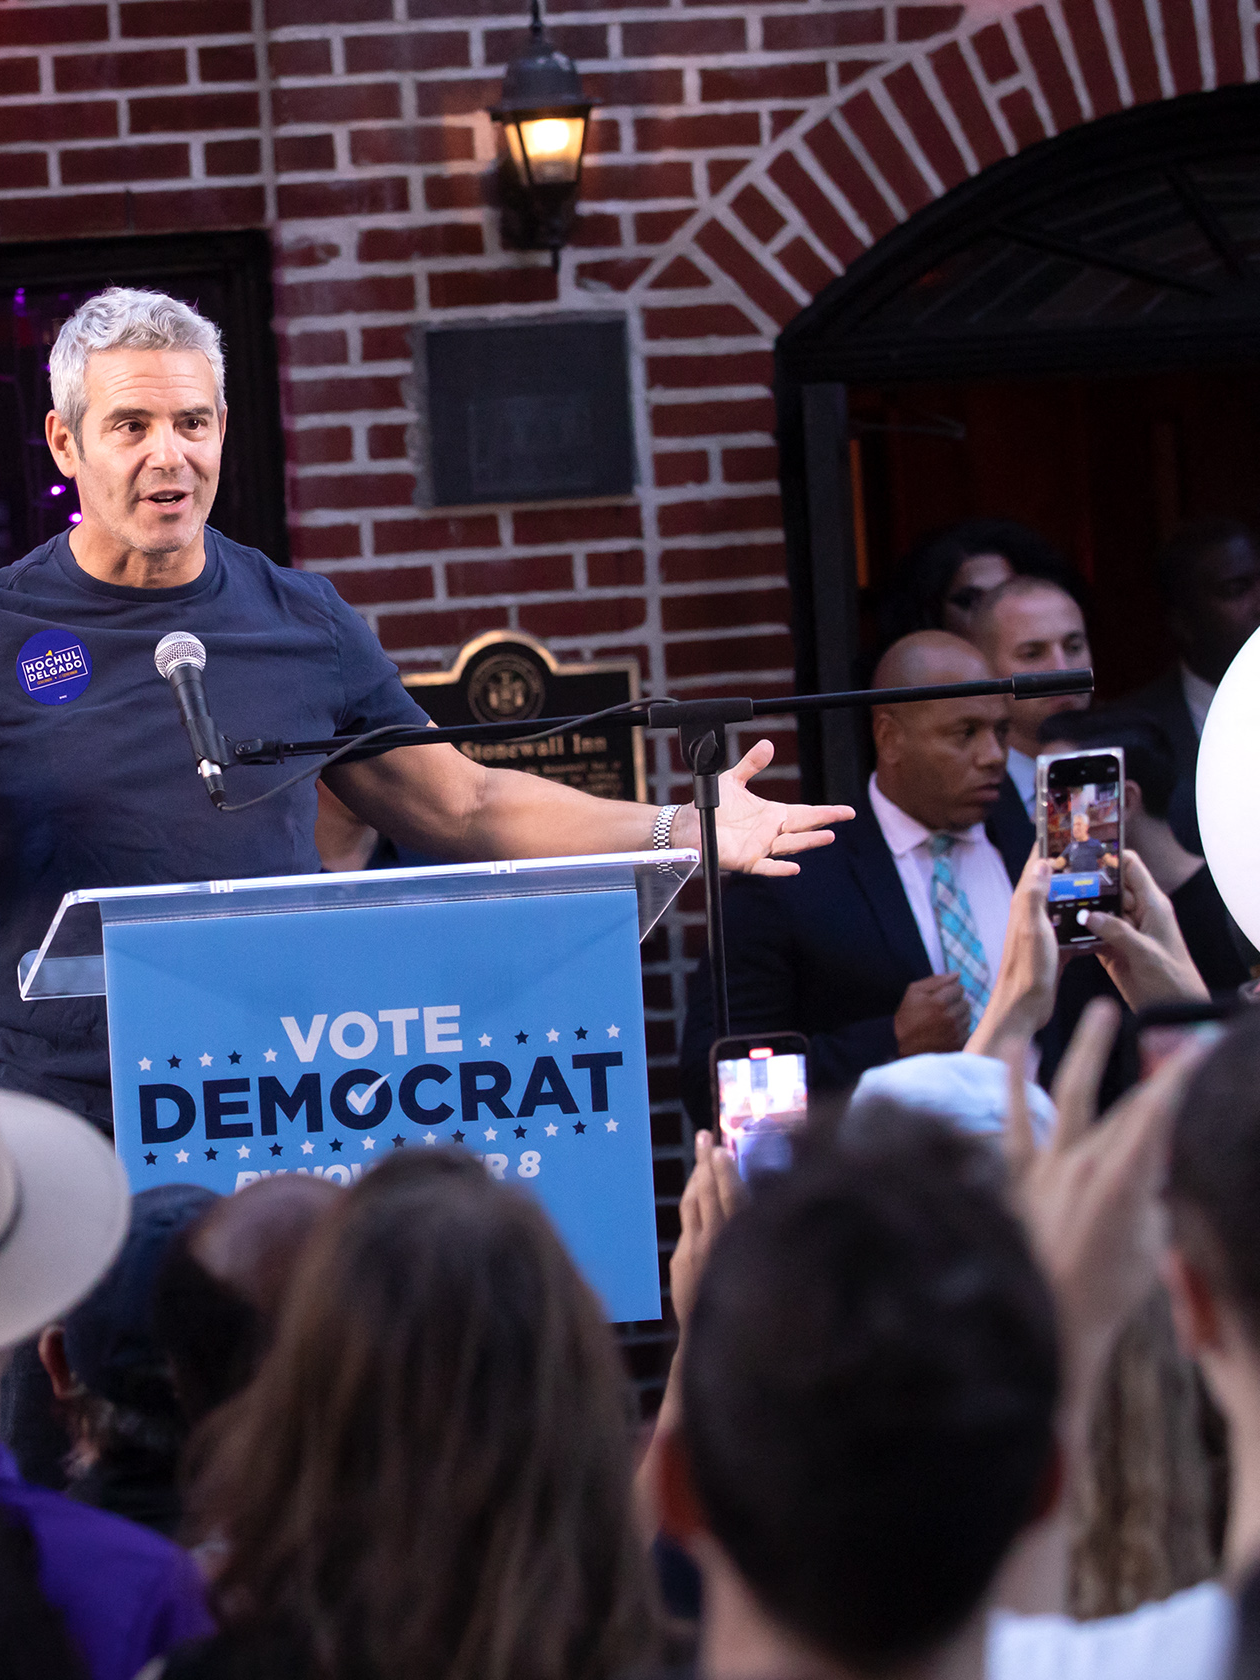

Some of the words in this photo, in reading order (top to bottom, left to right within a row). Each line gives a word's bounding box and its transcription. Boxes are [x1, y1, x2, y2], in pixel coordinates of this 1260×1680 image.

[25, 650, 80, 674] HOCHUL
[28, 660, 82, 682] DELGADO
[280, 1005, 463, 1063] VOTE
[138, 1051, 624, 1145] DEMOCRAT
[517, 1150, 542, 1178] 8
